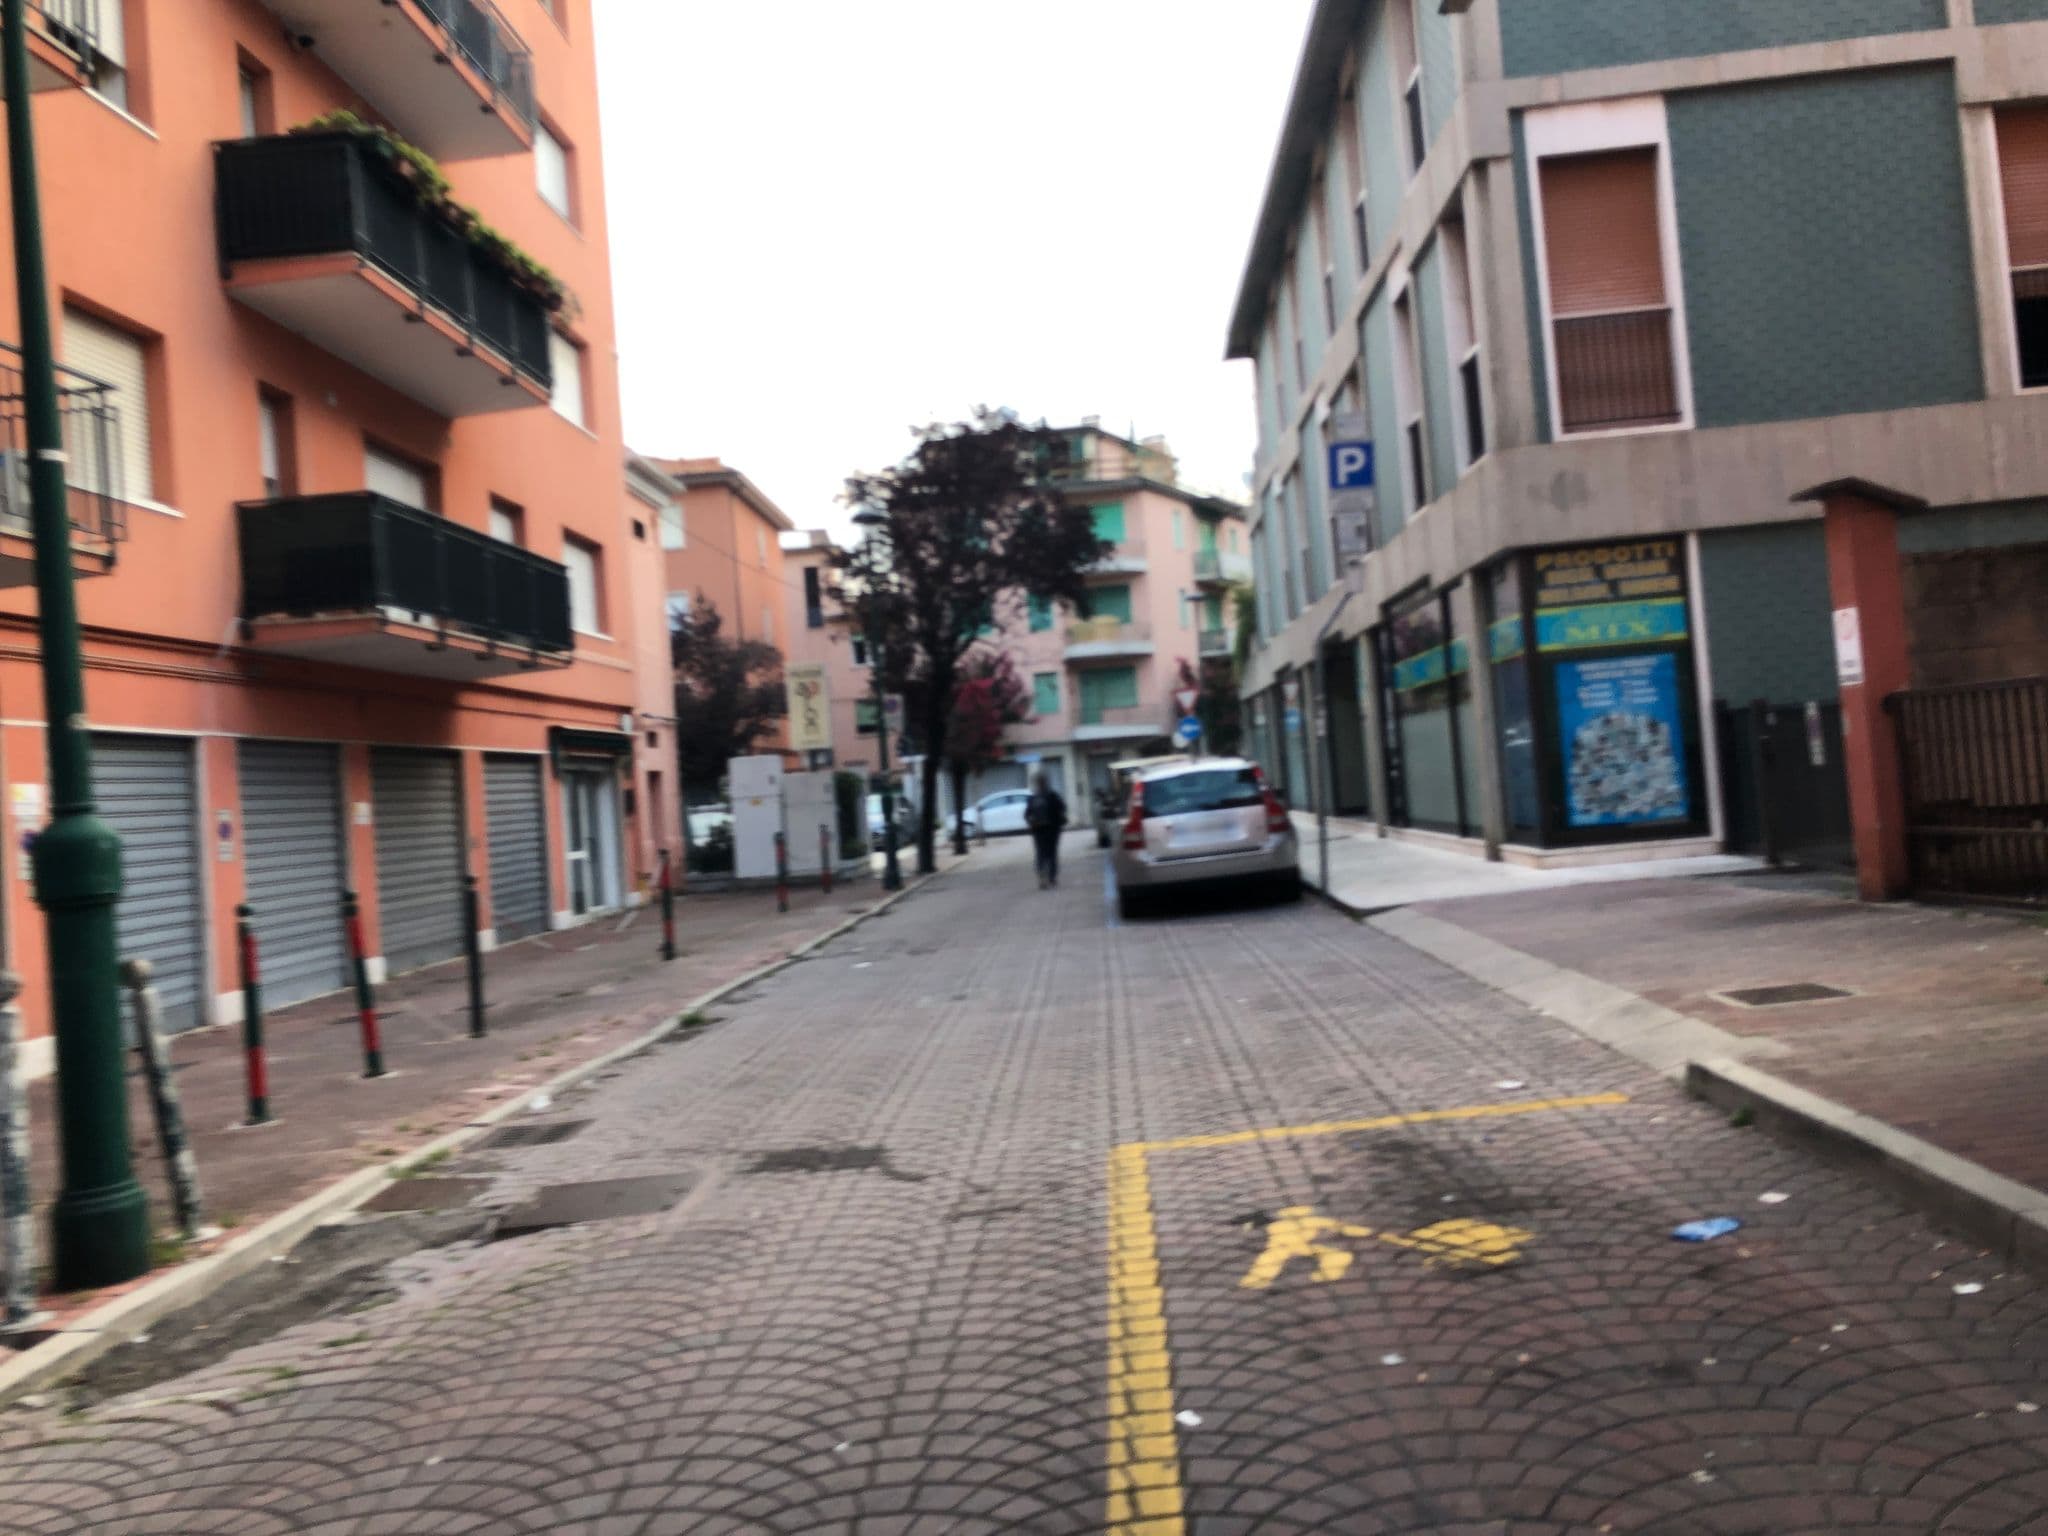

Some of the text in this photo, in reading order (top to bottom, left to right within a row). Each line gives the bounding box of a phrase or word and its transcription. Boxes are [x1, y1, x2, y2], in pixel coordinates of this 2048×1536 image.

[1336, 447, 1366, 484] P
[1536, 542, 1677, 571] PRODOTTI
[1565, 619, 1651, 643] MIX
